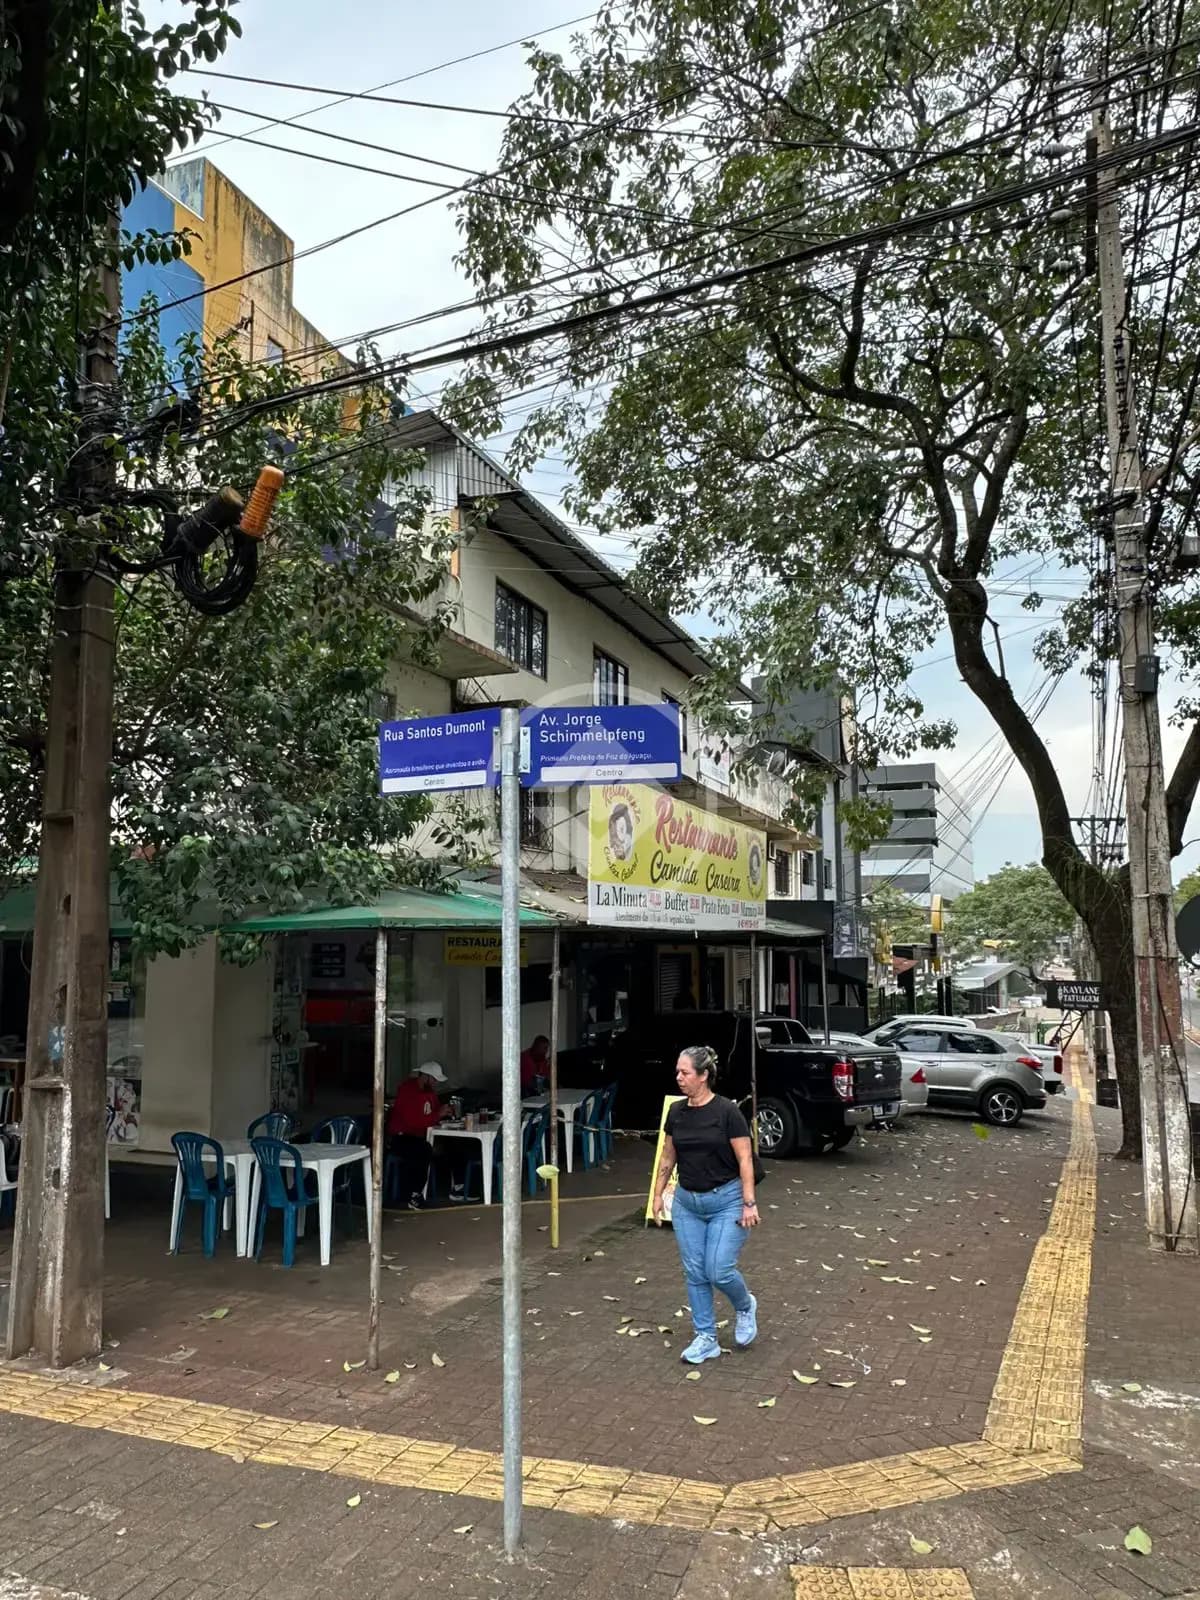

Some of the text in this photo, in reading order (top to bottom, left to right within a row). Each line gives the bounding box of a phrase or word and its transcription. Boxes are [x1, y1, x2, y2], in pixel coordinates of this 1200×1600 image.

[539, 713, 602, 728] Av. Jorge
[384, 719, 486, 742] Rua Santos Dumont
[540, 728, 646, 744] Schimmelpfeng
[540, 754, 568, 762] Primeiro
[569, 753, 595, 761] Prefeito
[606, 752, 618, 760] Foz
[619, 752, 628, 760] do
[435, 762, 445, 771] que
[596, 768, 623, 778] Centro
[423, 777, 446, 787] Centro
[655, 793, 739, 861] Restaurante
[596, 884, 610, 906] La
[612, 886, 648, 909] Minuta
[664, 891, 689, 913] Buffet
[447, 936, 528, 949] RESTAURAE
[1063, 985, 1101, 995] KAYLANE
[1063, 994, 1101, 1003] TATUAGEM
